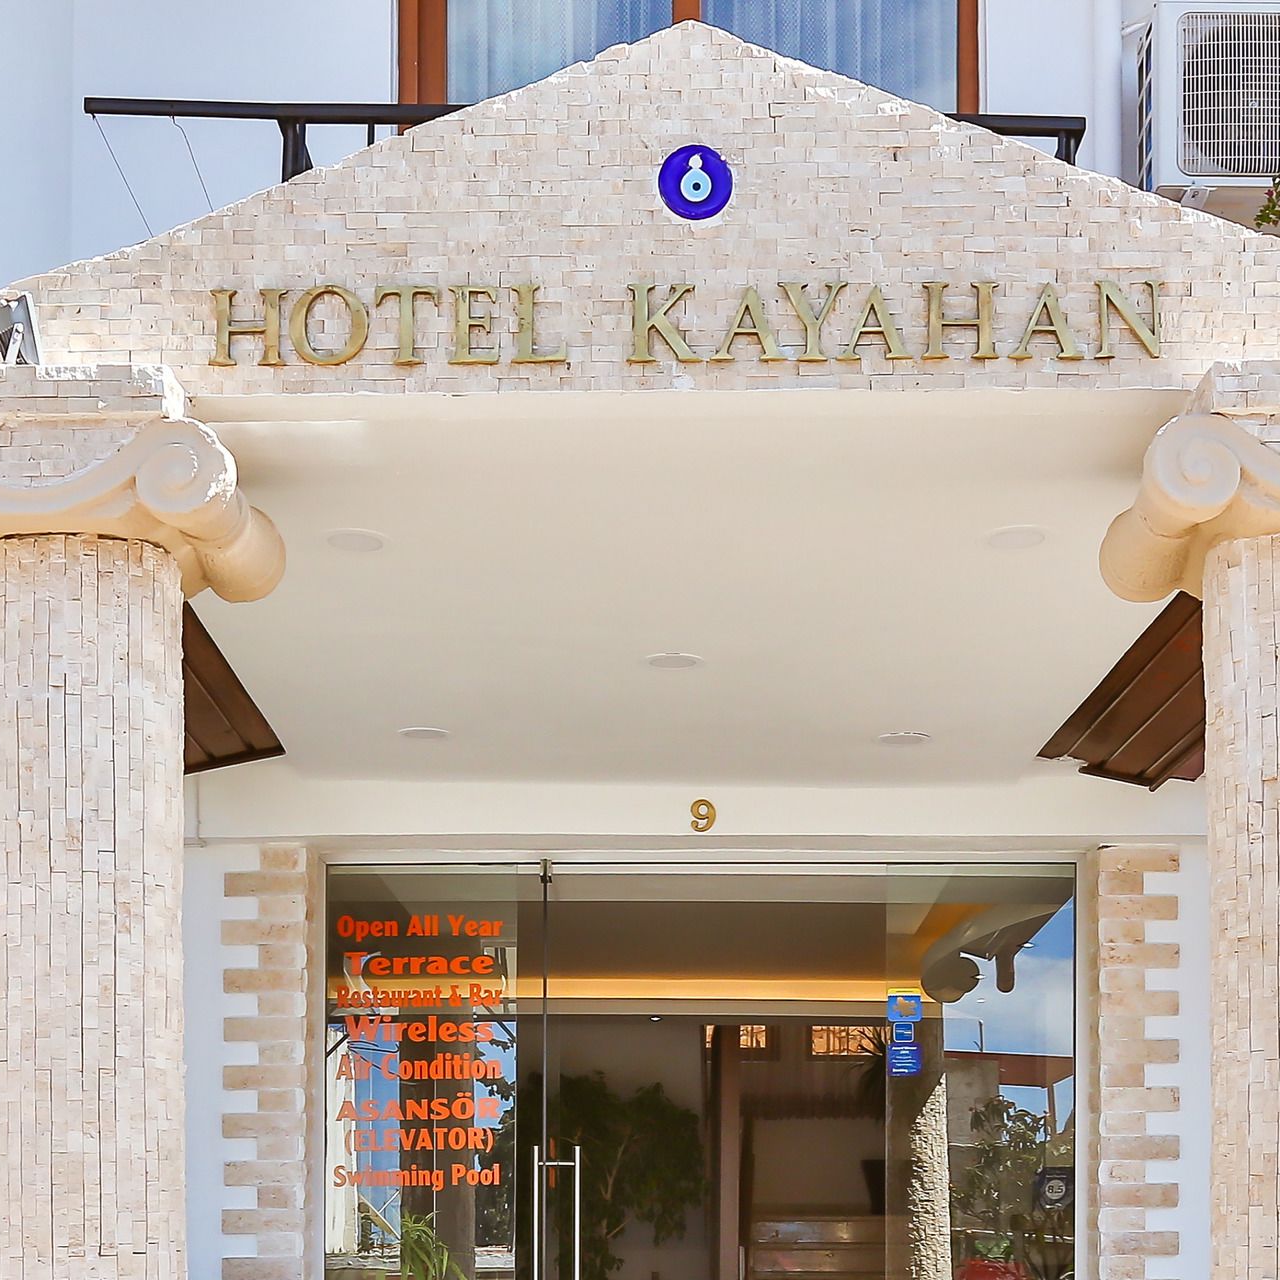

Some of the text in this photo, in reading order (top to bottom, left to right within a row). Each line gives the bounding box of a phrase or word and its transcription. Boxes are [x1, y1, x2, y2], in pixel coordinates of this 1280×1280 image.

[209, 281, 1164, 366] HOTEL KAYAHAN
[690, 799, 716, 832] 9
[337, 914, 503, 942] Open All Year
[344, 952, 494, 975] Terrace
[336, 984, 502, 1008] Restaurant & Bar
[345, 1015, 494, 1042] Wireless
[336, 1053, 502, 1080] Air Condition
[336, 1092, 501, 1121] ASANSÖR
[345, 1127, 494, 1155] (ELEVATOR)
[333, 1163, 500, 1191] Swimming Pool
